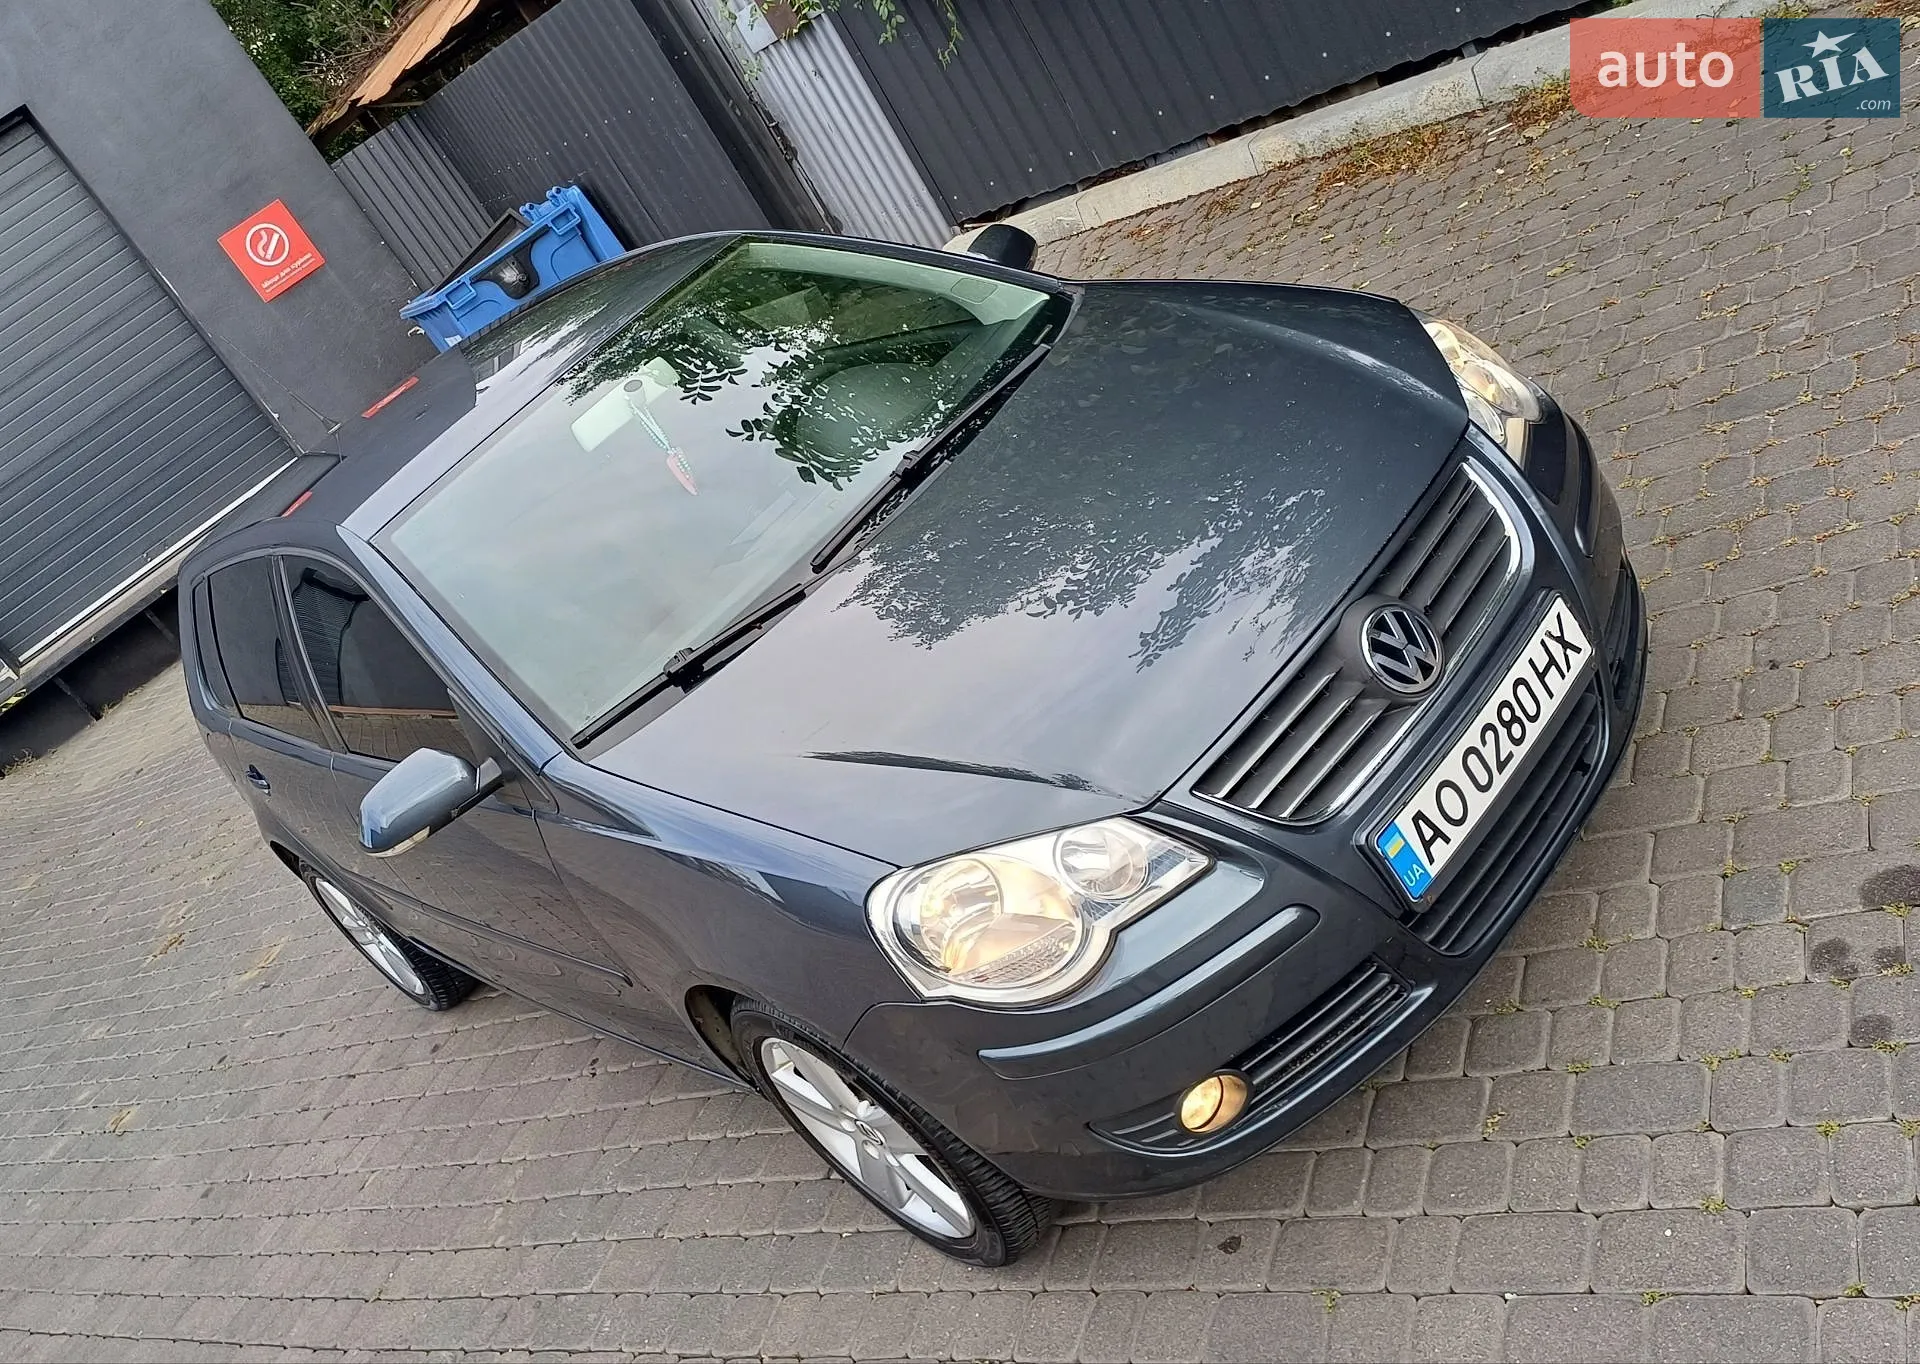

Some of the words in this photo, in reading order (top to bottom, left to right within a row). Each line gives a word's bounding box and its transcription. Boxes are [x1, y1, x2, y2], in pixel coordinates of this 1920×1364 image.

[1363, 606, 1442, 692] VW
[1411, 779, 1468, 865] AO
[1461, 676, 1541, 794] 0280
[1528, 612, 1582, 700] HX
[1403, 862, 1425, 887] UA
